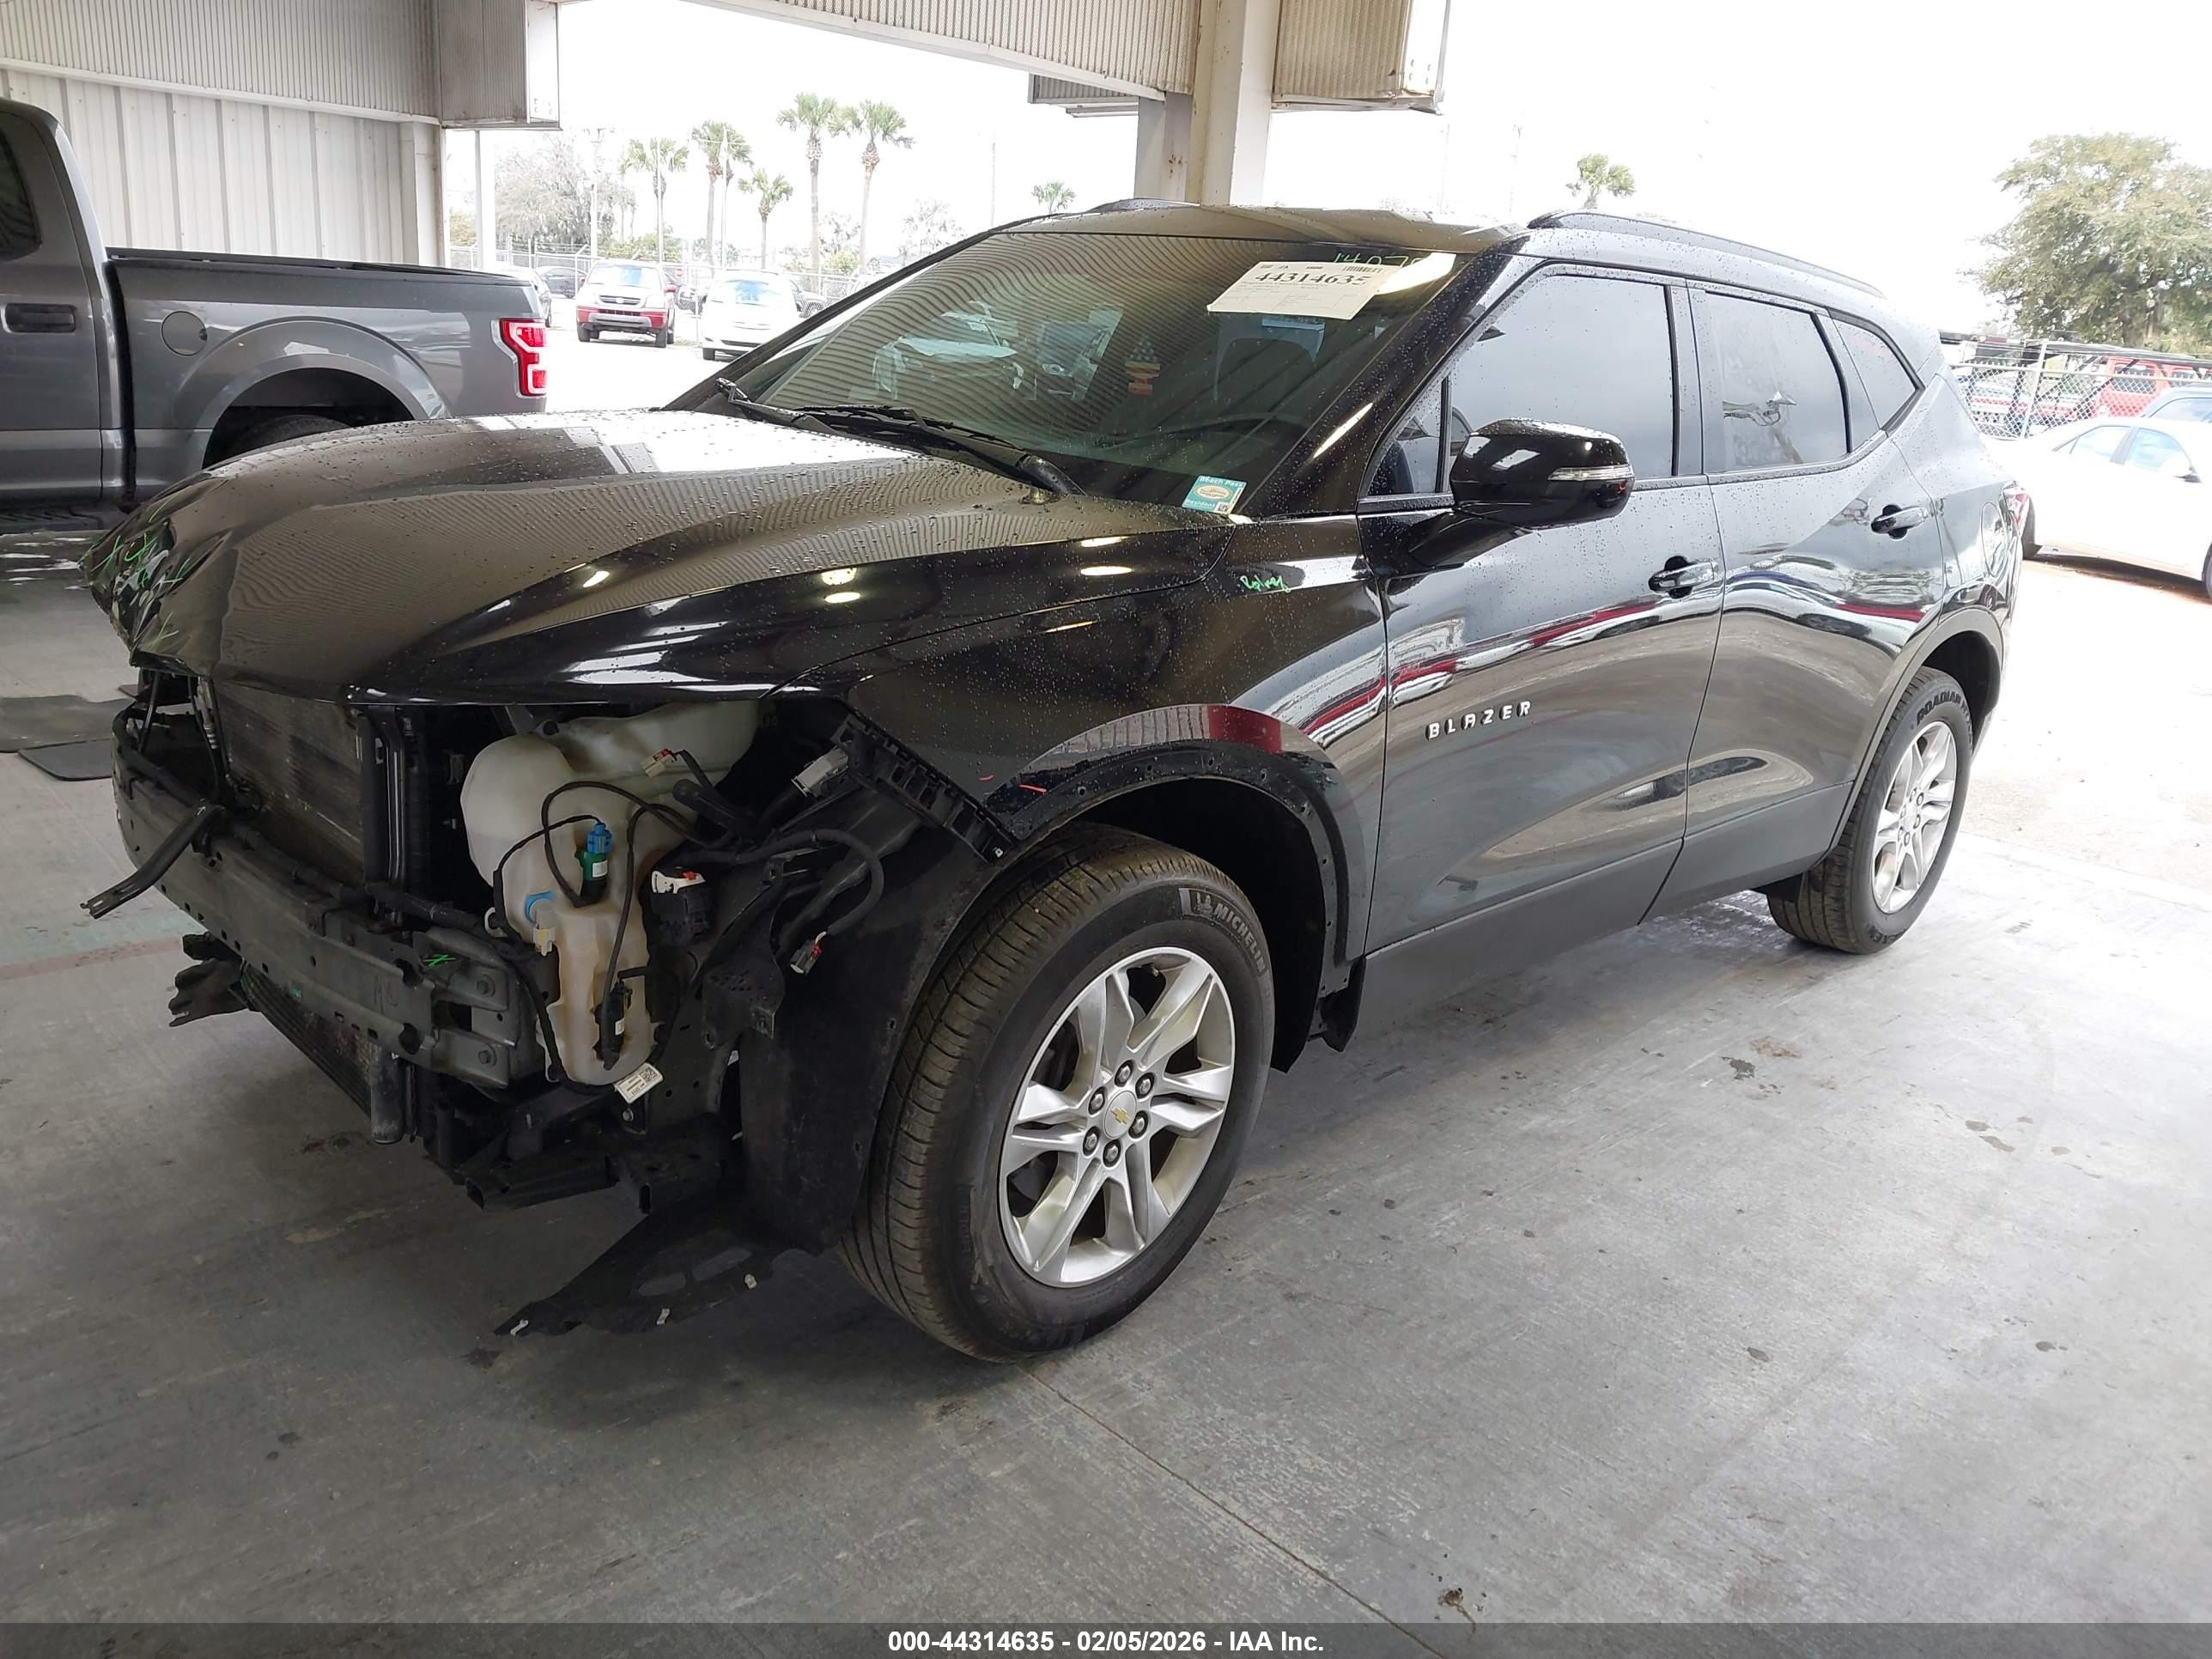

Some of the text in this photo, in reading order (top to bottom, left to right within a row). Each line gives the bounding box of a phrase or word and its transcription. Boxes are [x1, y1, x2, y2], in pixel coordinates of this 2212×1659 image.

[1255, 272, 1371, 286] 44314635
[1425, 701, 1531, 741] BLAZER
[1213, 902, 1267, 972] MICHELIN
